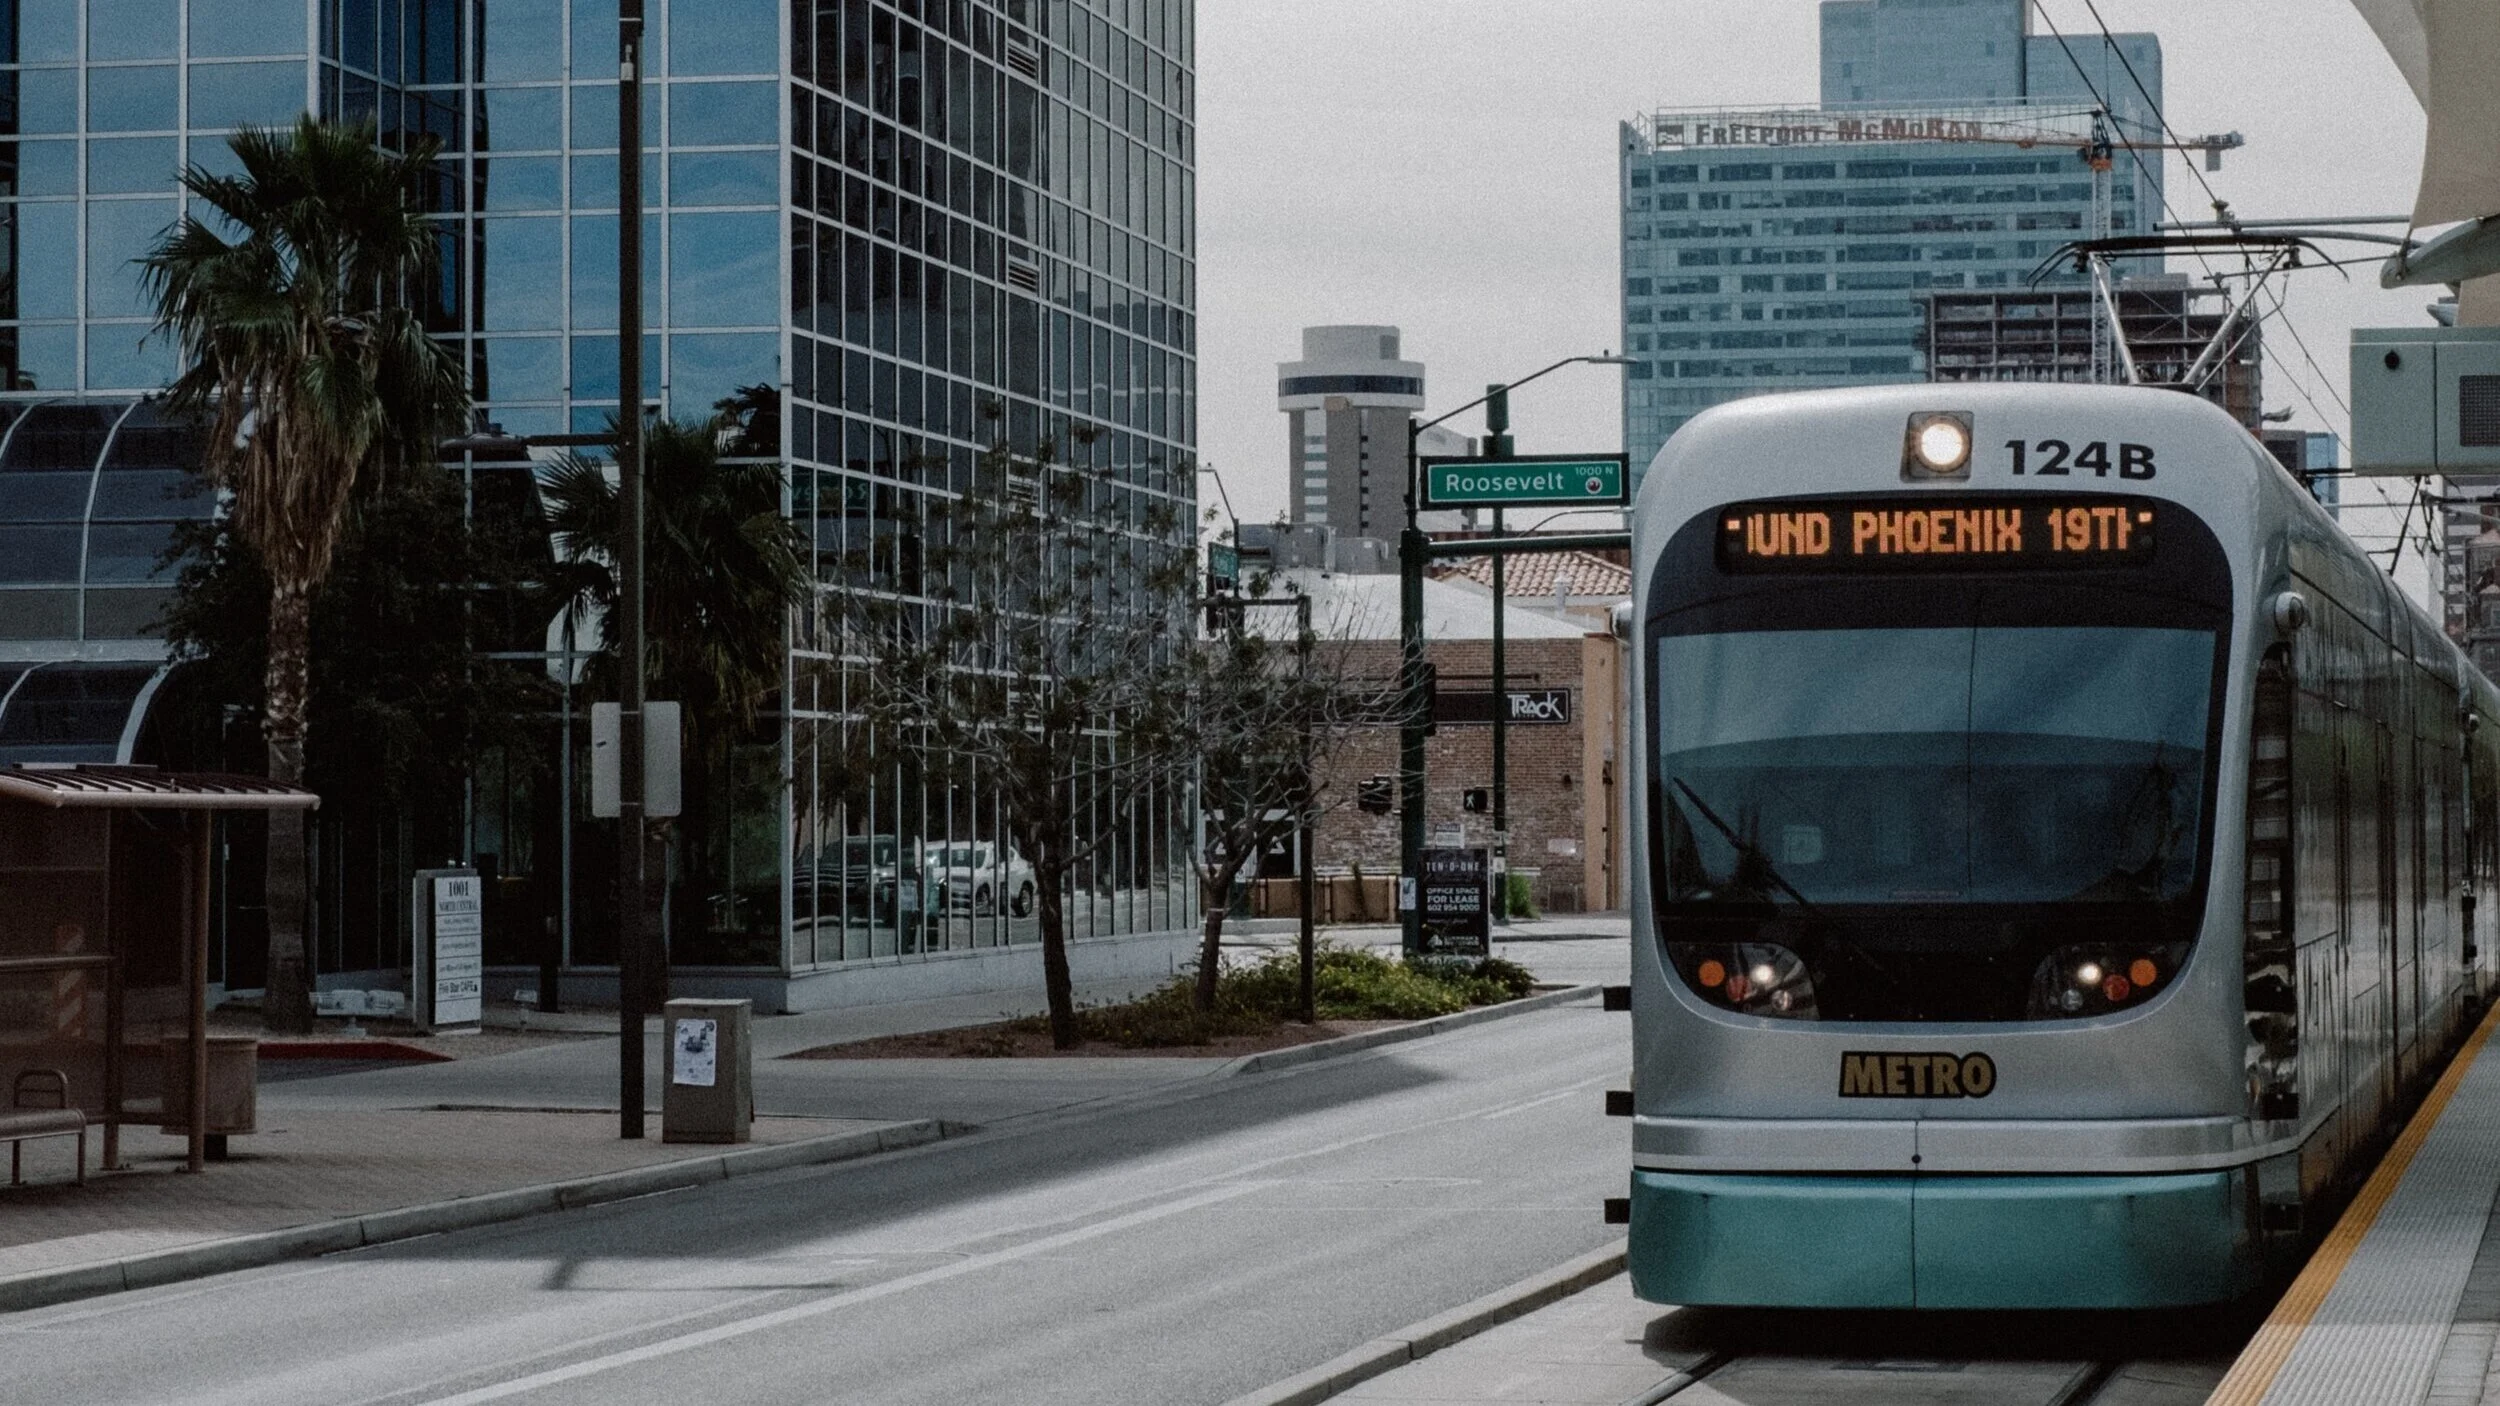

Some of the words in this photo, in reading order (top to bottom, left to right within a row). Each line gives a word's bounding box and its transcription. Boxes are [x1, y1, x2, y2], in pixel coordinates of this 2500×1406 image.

[2005, 439, 2157, 481] 124B
[1575, 467, 1602, 476] 1000
[1605, 467, 1614, 475] N
[1446, 473, 1565, 493] Roosevelt
[1853, 508, 2022, 554] PHOENIX
[448, 881, 469, 896] 1001
[1426, 887, 1454, 895] OFFICE
[1455, 887, 1480, 895] SPACE
[1427, 895, 1447, 903] FOR
[1449, 895, 1480, 903] LEASE
[1841, 1053, 1995, 1097] METRO
